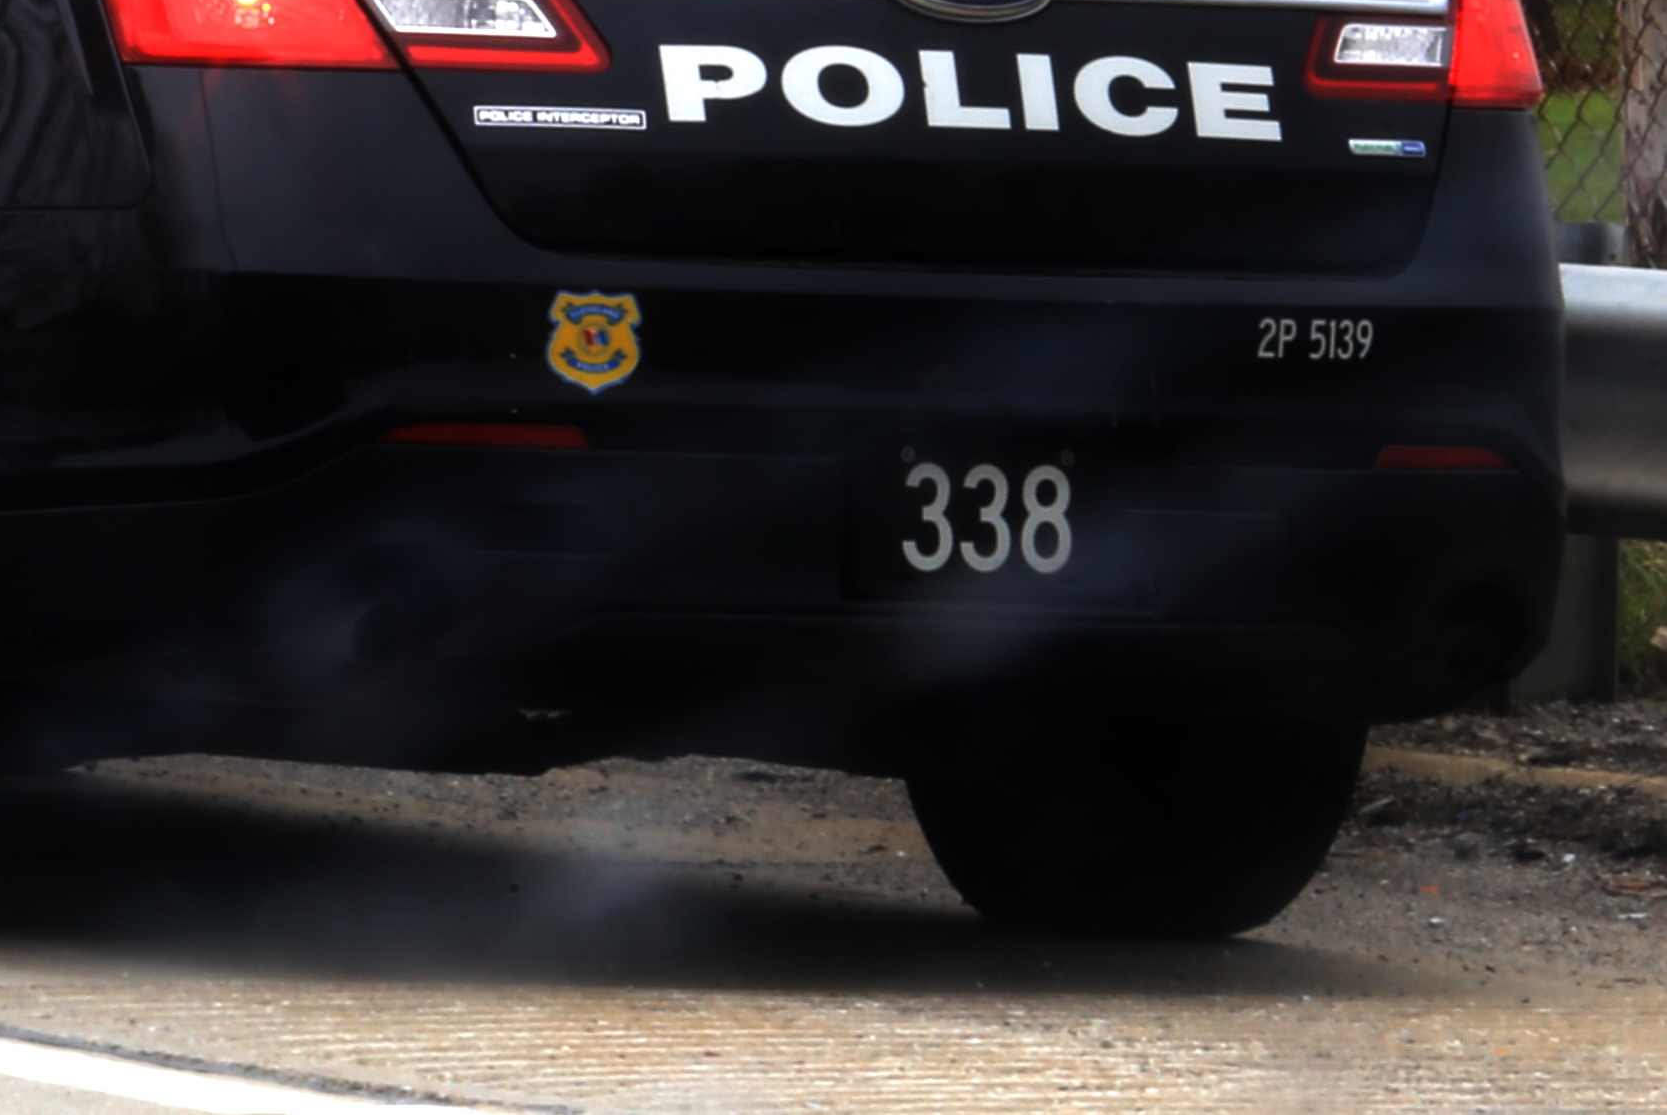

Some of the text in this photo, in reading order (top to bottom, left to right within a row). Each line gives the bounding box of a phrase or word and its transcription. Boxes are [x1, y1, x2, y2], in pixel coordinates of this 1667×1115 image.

[479, 110, 640, 125] POLICE INTERCEPTOR
[658, 44, 1282, 142] POLICE
[1257, 318, 1374, 359] 2P 5139
[902, 463, 1073, 574] 338
